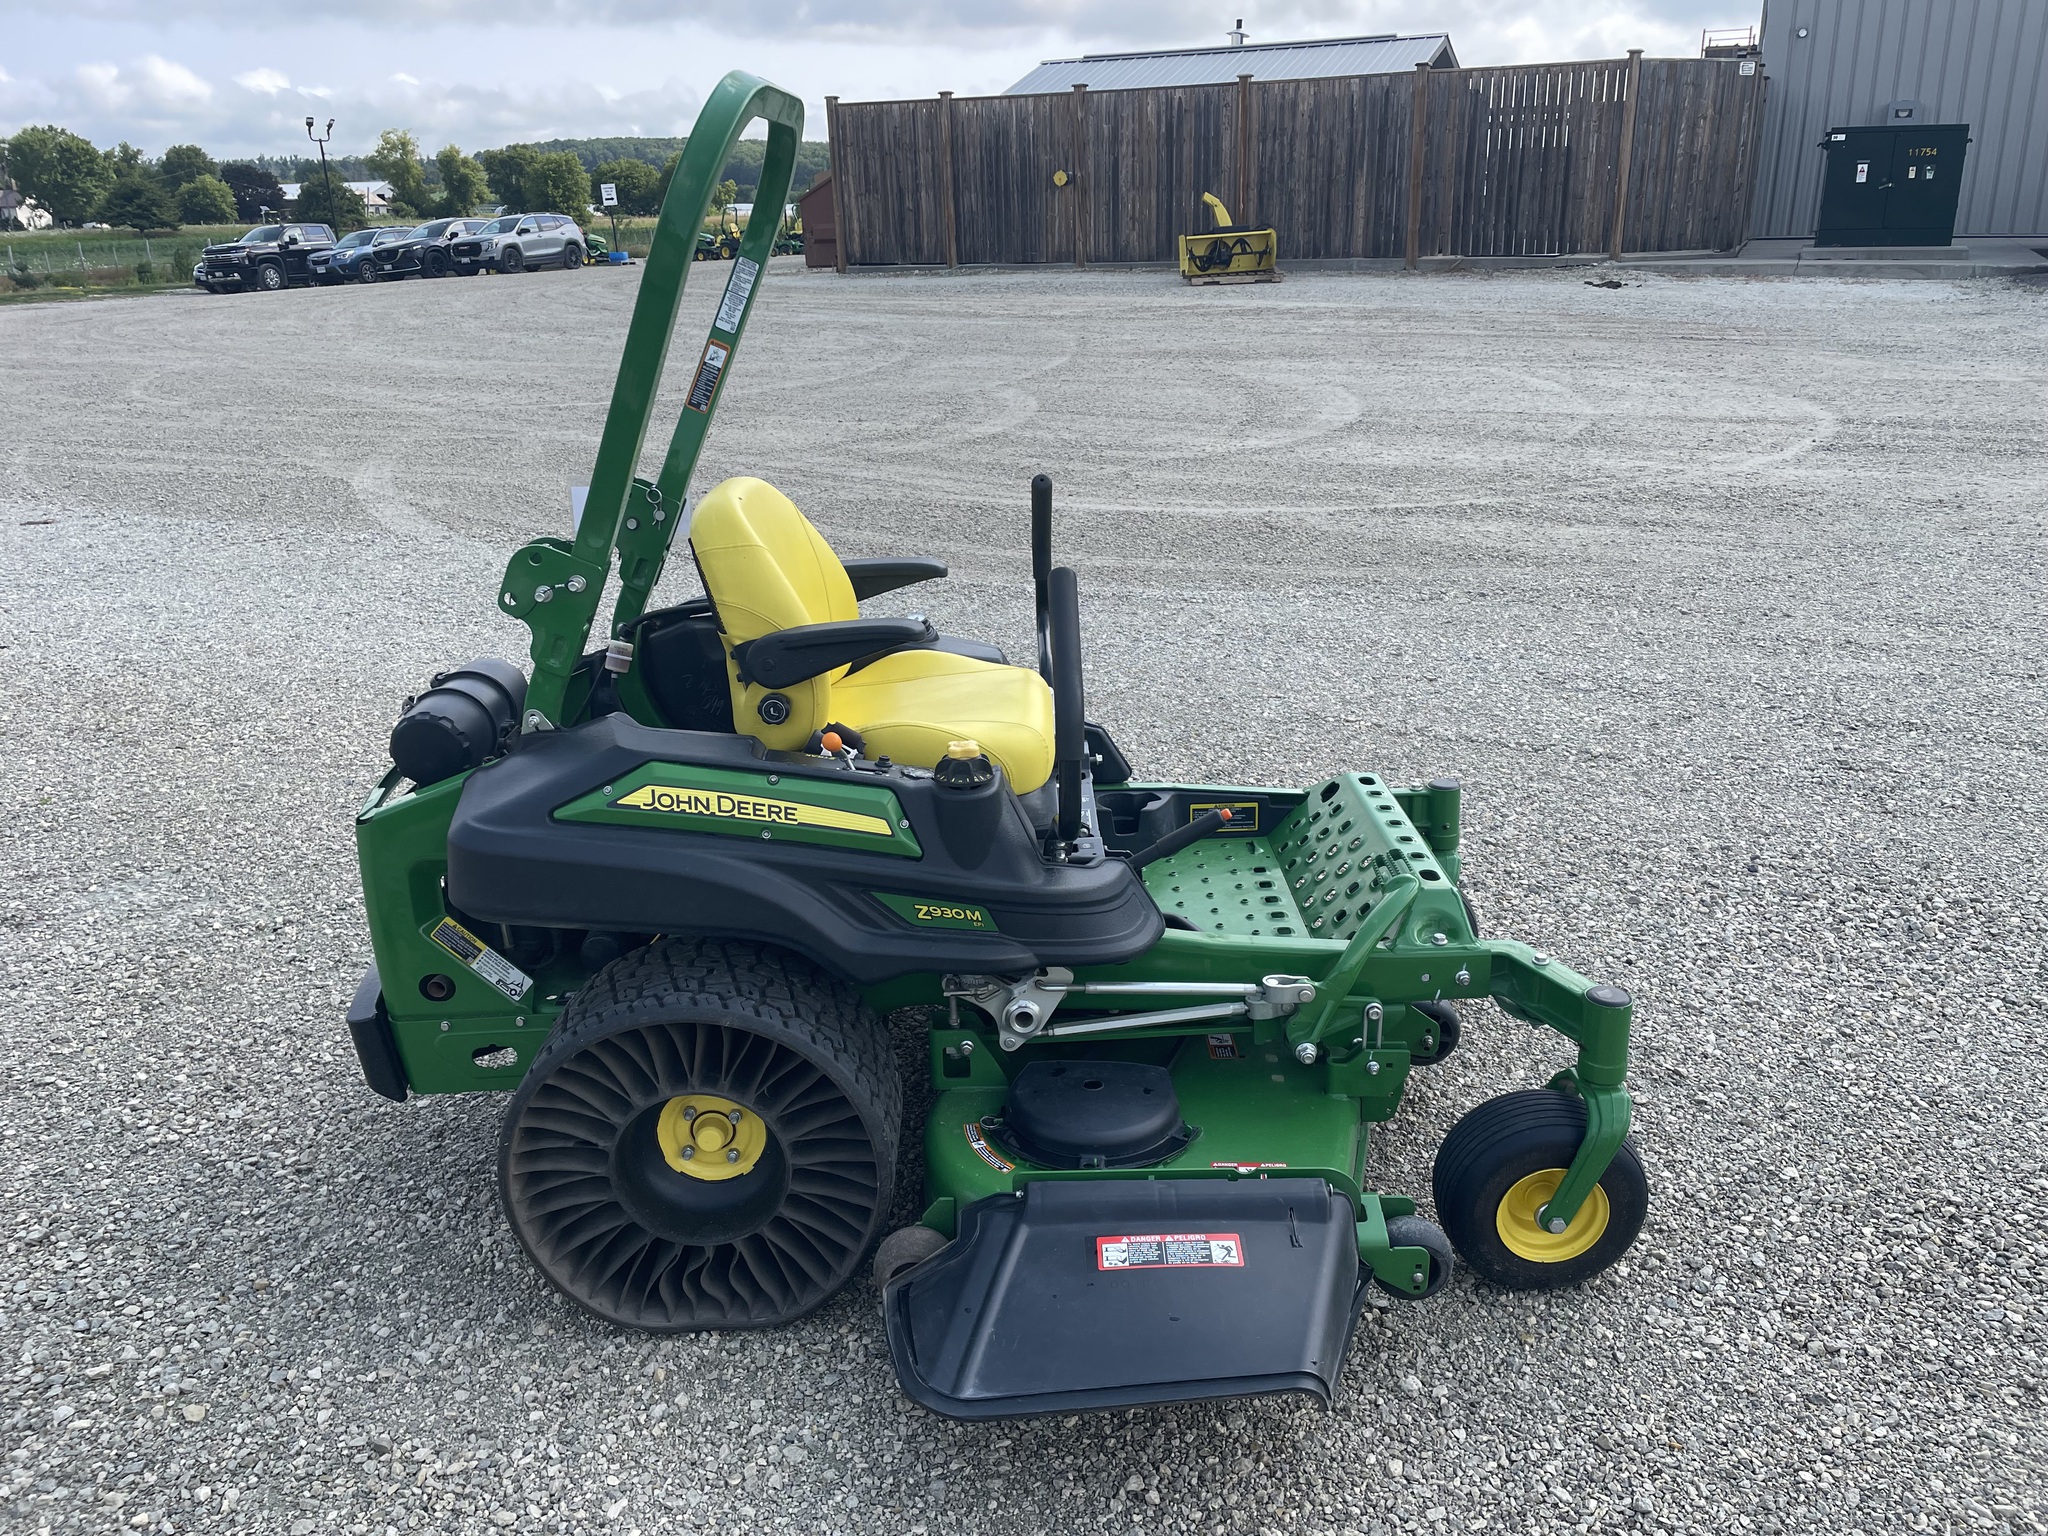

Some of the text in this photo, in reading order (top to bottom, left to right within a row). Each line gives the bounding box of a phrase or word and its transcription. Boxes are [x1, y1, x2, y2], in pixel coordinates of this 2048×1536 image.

[1908, 147, 1938, 156] 11754
[642, 788, 799, 822] JOHN DEERE
[457, 926, 478, 944] CAUTION
